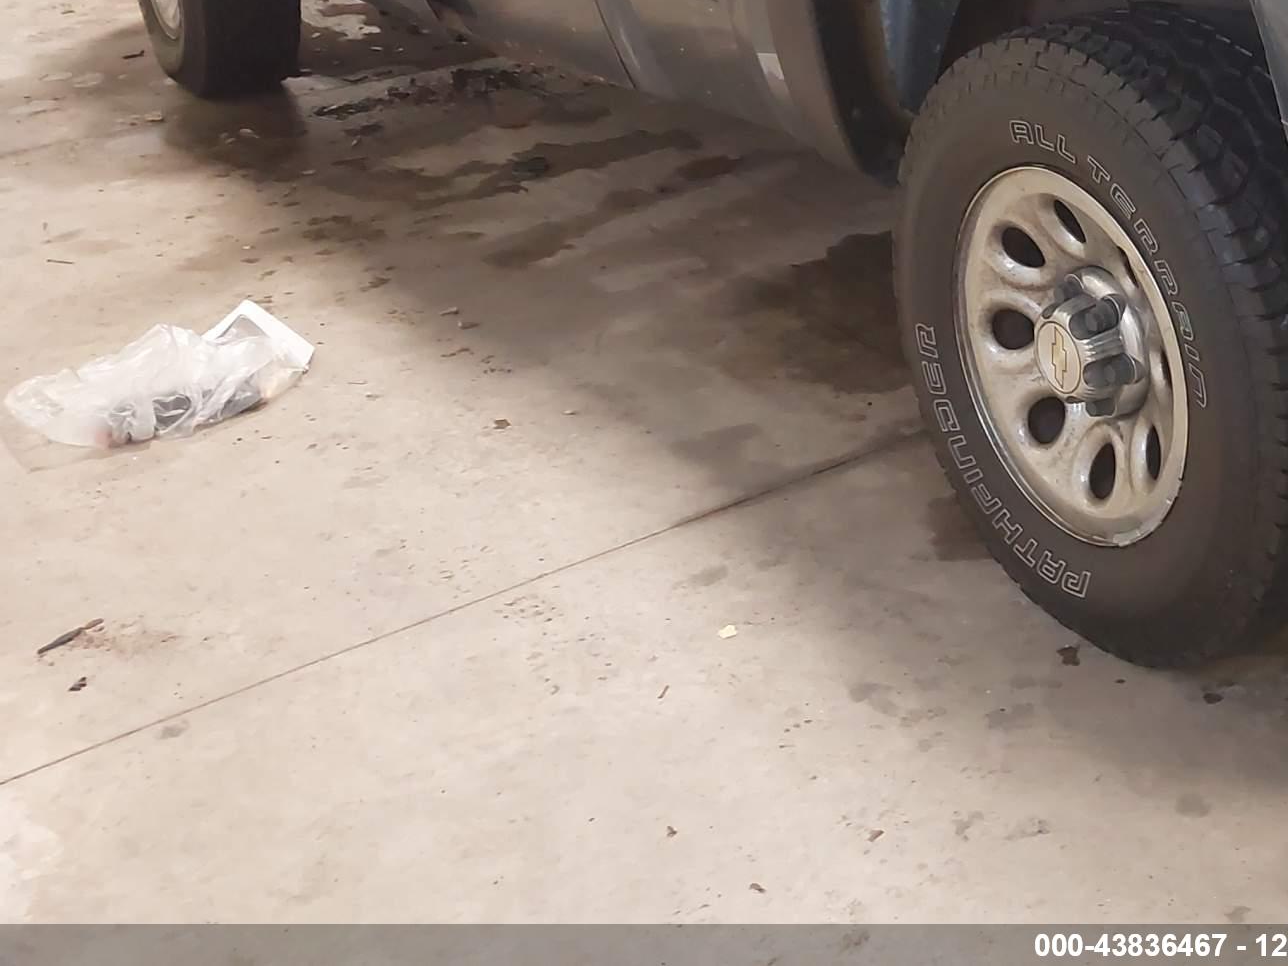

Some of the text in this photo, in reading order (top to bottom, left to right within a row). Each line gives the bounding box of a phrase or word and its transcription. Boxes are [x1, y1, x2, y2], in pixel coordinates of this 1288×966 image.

[1009, 119, 1207, 408] ALL TERRAIN
[915, 322, 1092, 598] PATHFINDER
